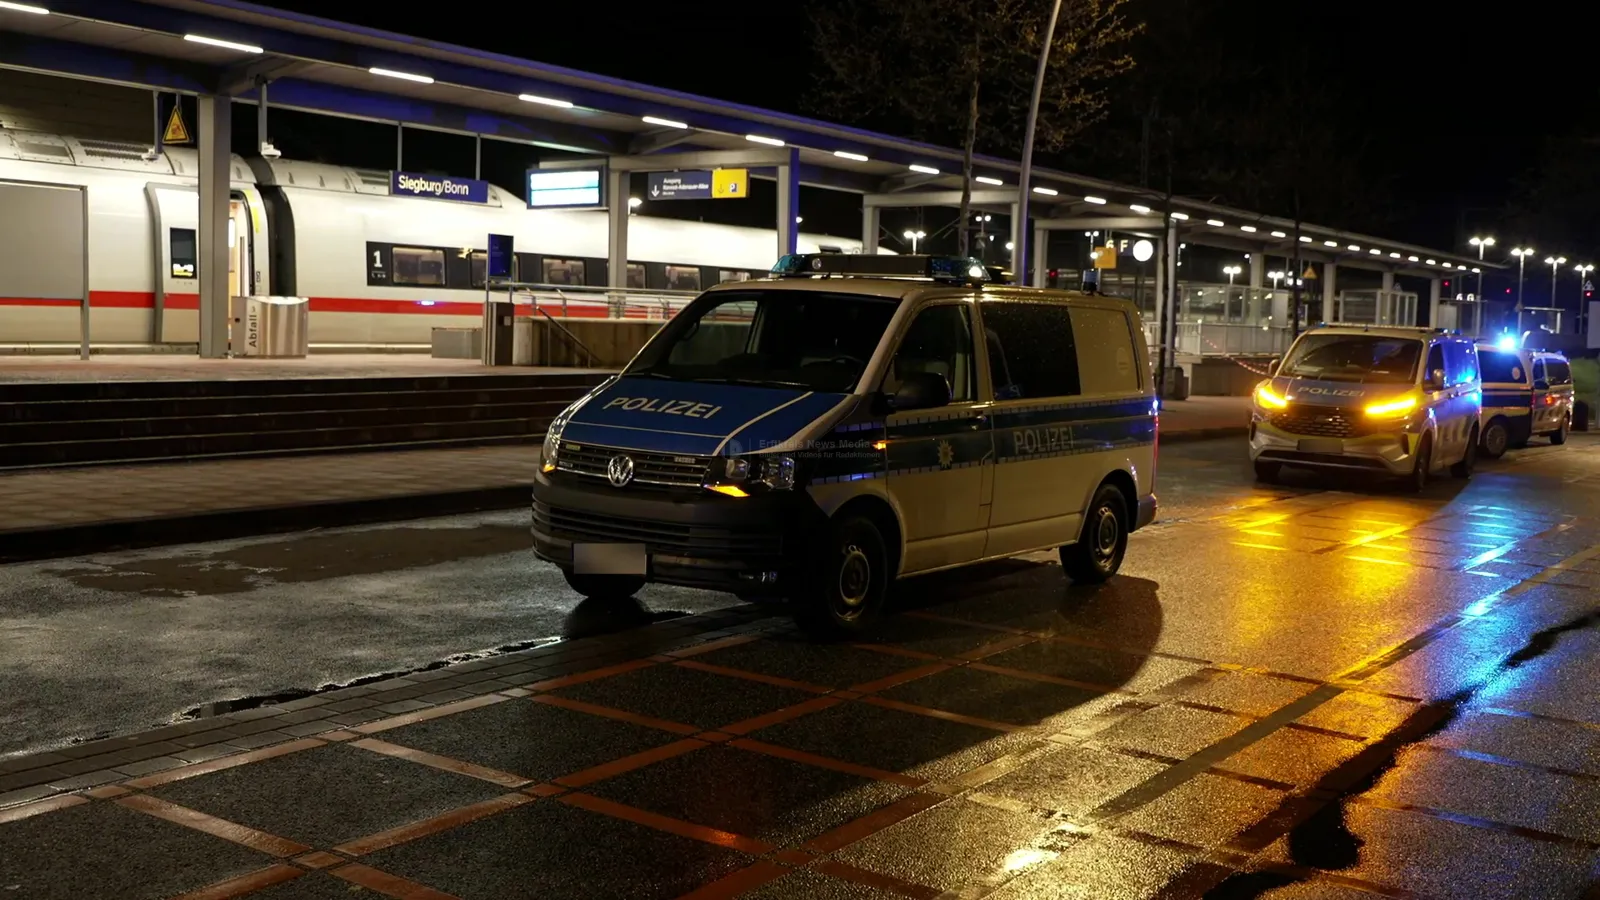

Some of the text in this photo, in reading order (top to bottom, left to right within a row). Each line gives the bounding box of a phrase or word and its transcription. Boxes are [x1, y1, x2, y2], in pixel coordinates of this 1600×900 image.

[398, 175, 469, 196] Siegburg/Bonn
[1120, 239, 1129, 253] F
[373, 250, 383, 268] 1
[248, 314, 258, 348] Abfall
[1296, 386, 1366, 397] POLIZEI
[602, 397, 722, 419] POLIZEI
[1013, 426, 1075, 455] POLIZEI
